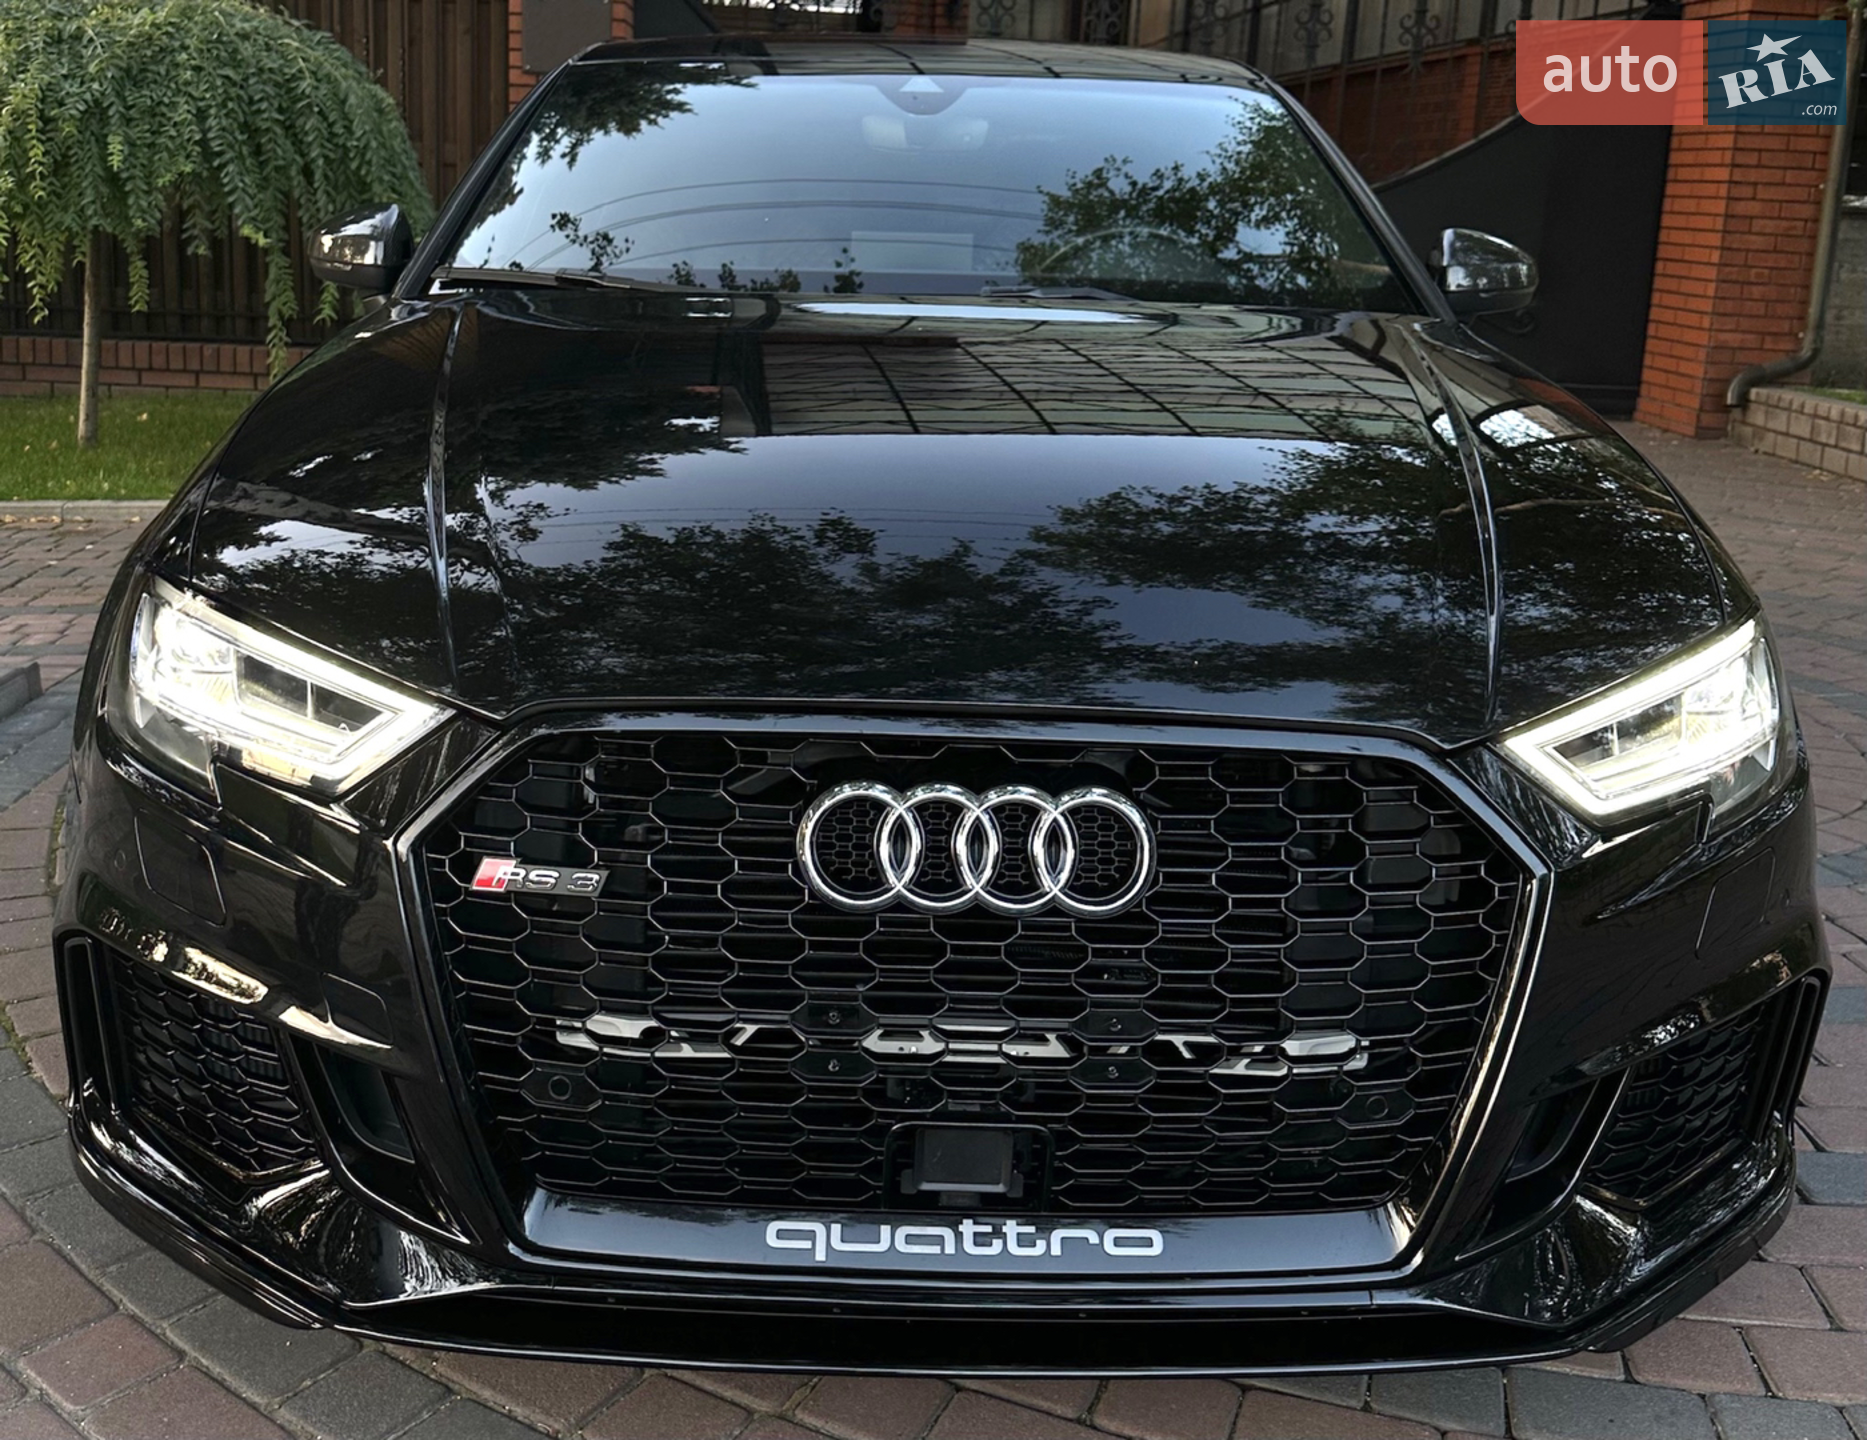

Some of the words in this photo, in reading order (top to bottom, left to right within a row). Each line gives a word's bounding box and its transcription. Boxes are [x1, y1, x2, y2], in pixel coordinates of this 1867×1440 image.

[491, 865, 560, 890] RS
[567, 872, 601, 893] 3
[765, 1218, 1164, 1262] quattro
